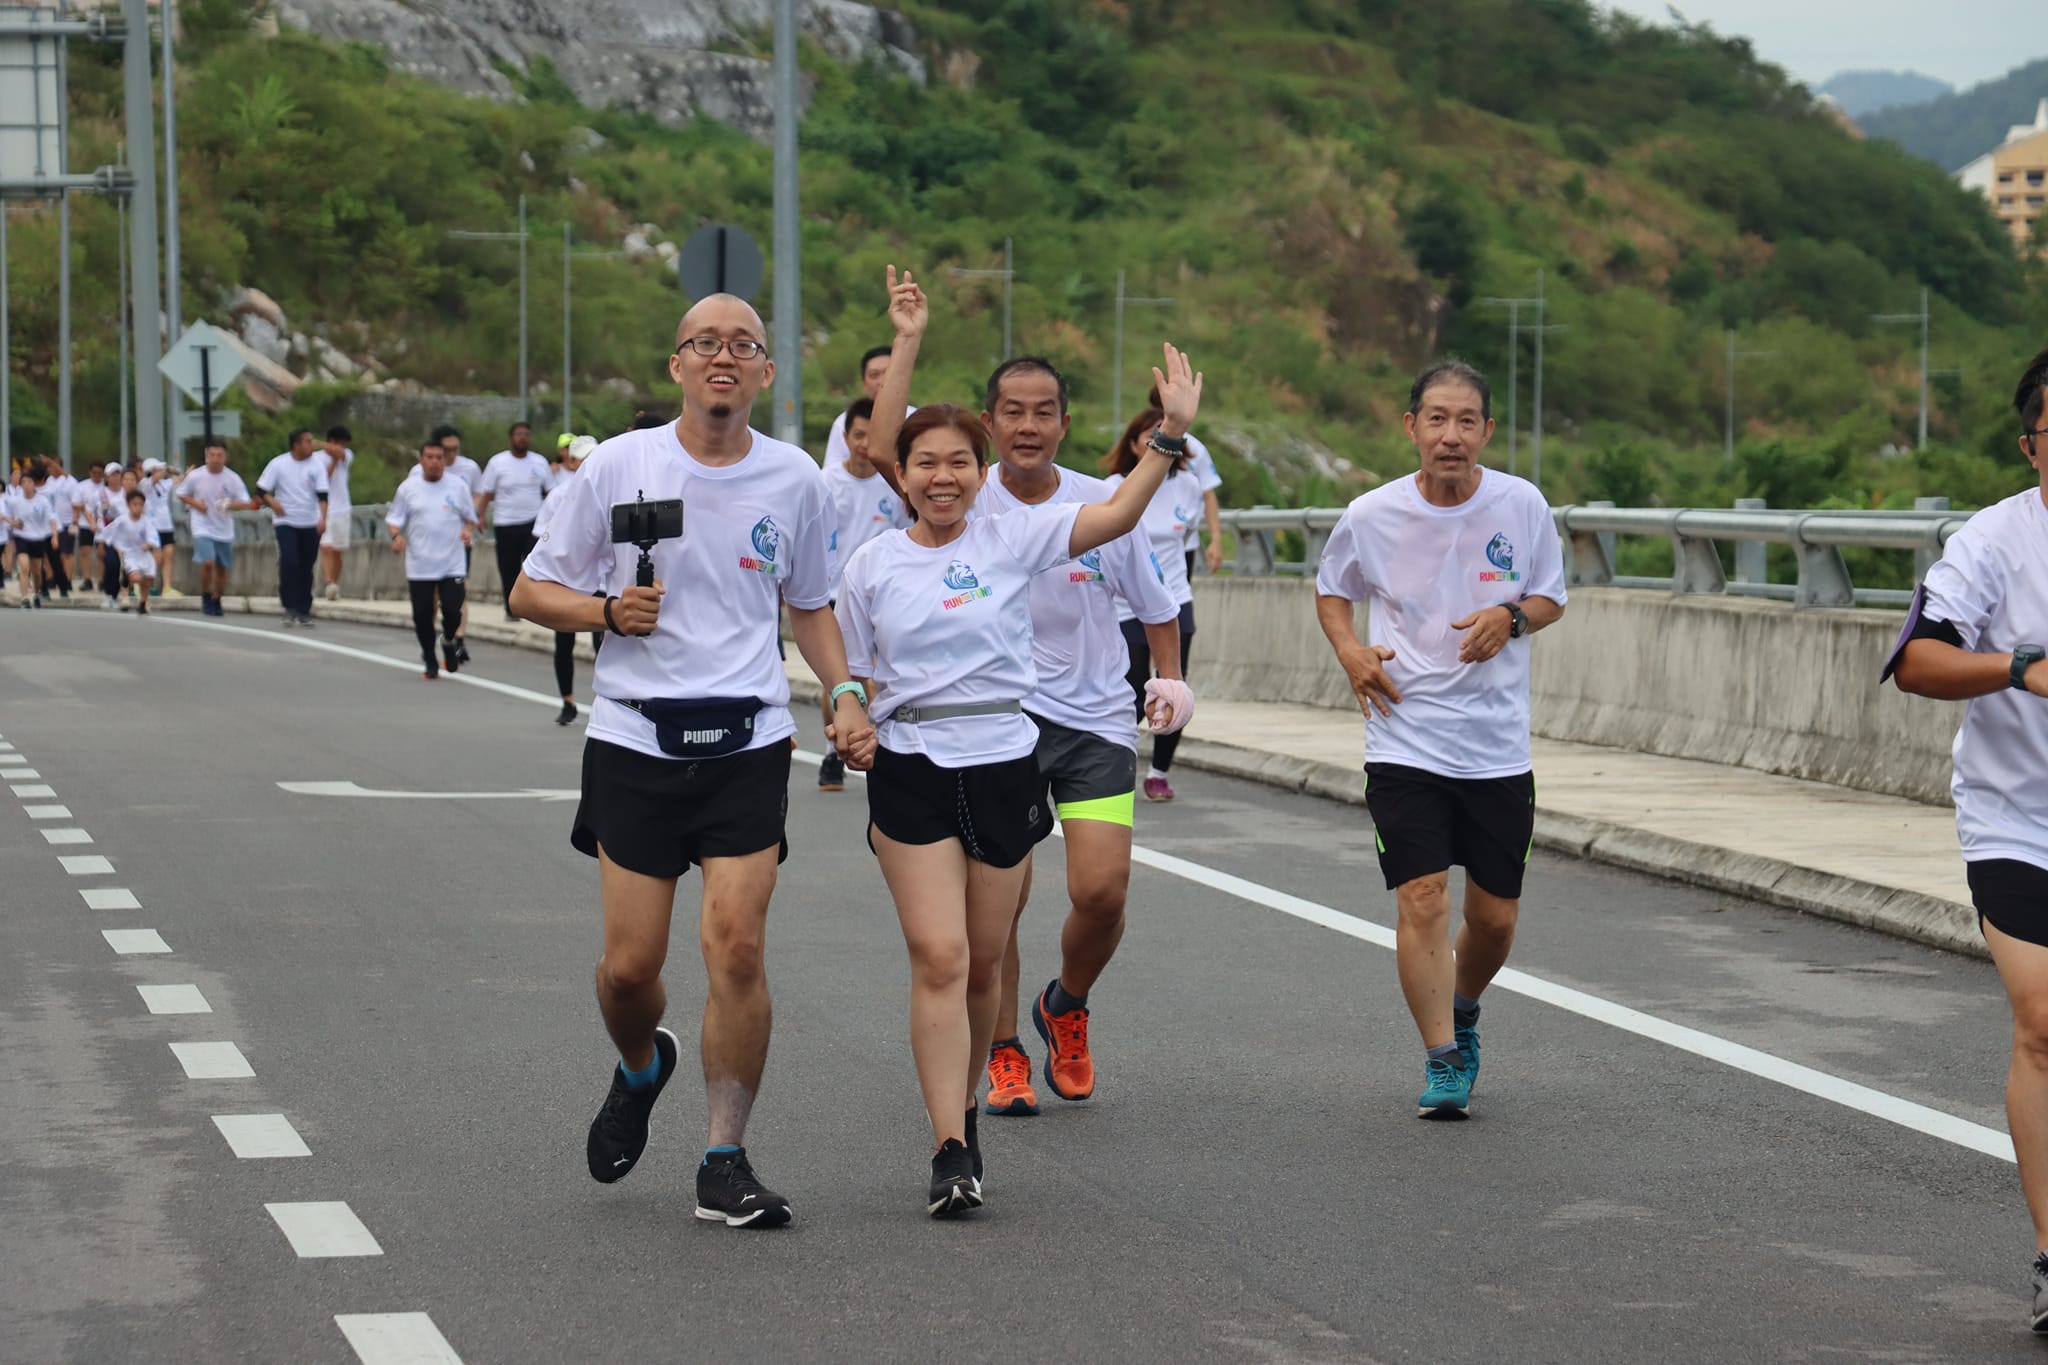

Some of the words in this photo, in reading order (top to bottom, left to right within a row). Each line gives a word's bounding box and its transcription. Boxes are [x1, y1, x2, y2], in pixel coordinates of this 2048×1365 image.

[739, 557, 757, 571] RUN
[1070, 571, 1086, 583] RUN
[1479, 571, 1495, 582] RUN
[943, 595, 964, 611] RUN
[970, 585, 993, 600] FUND
